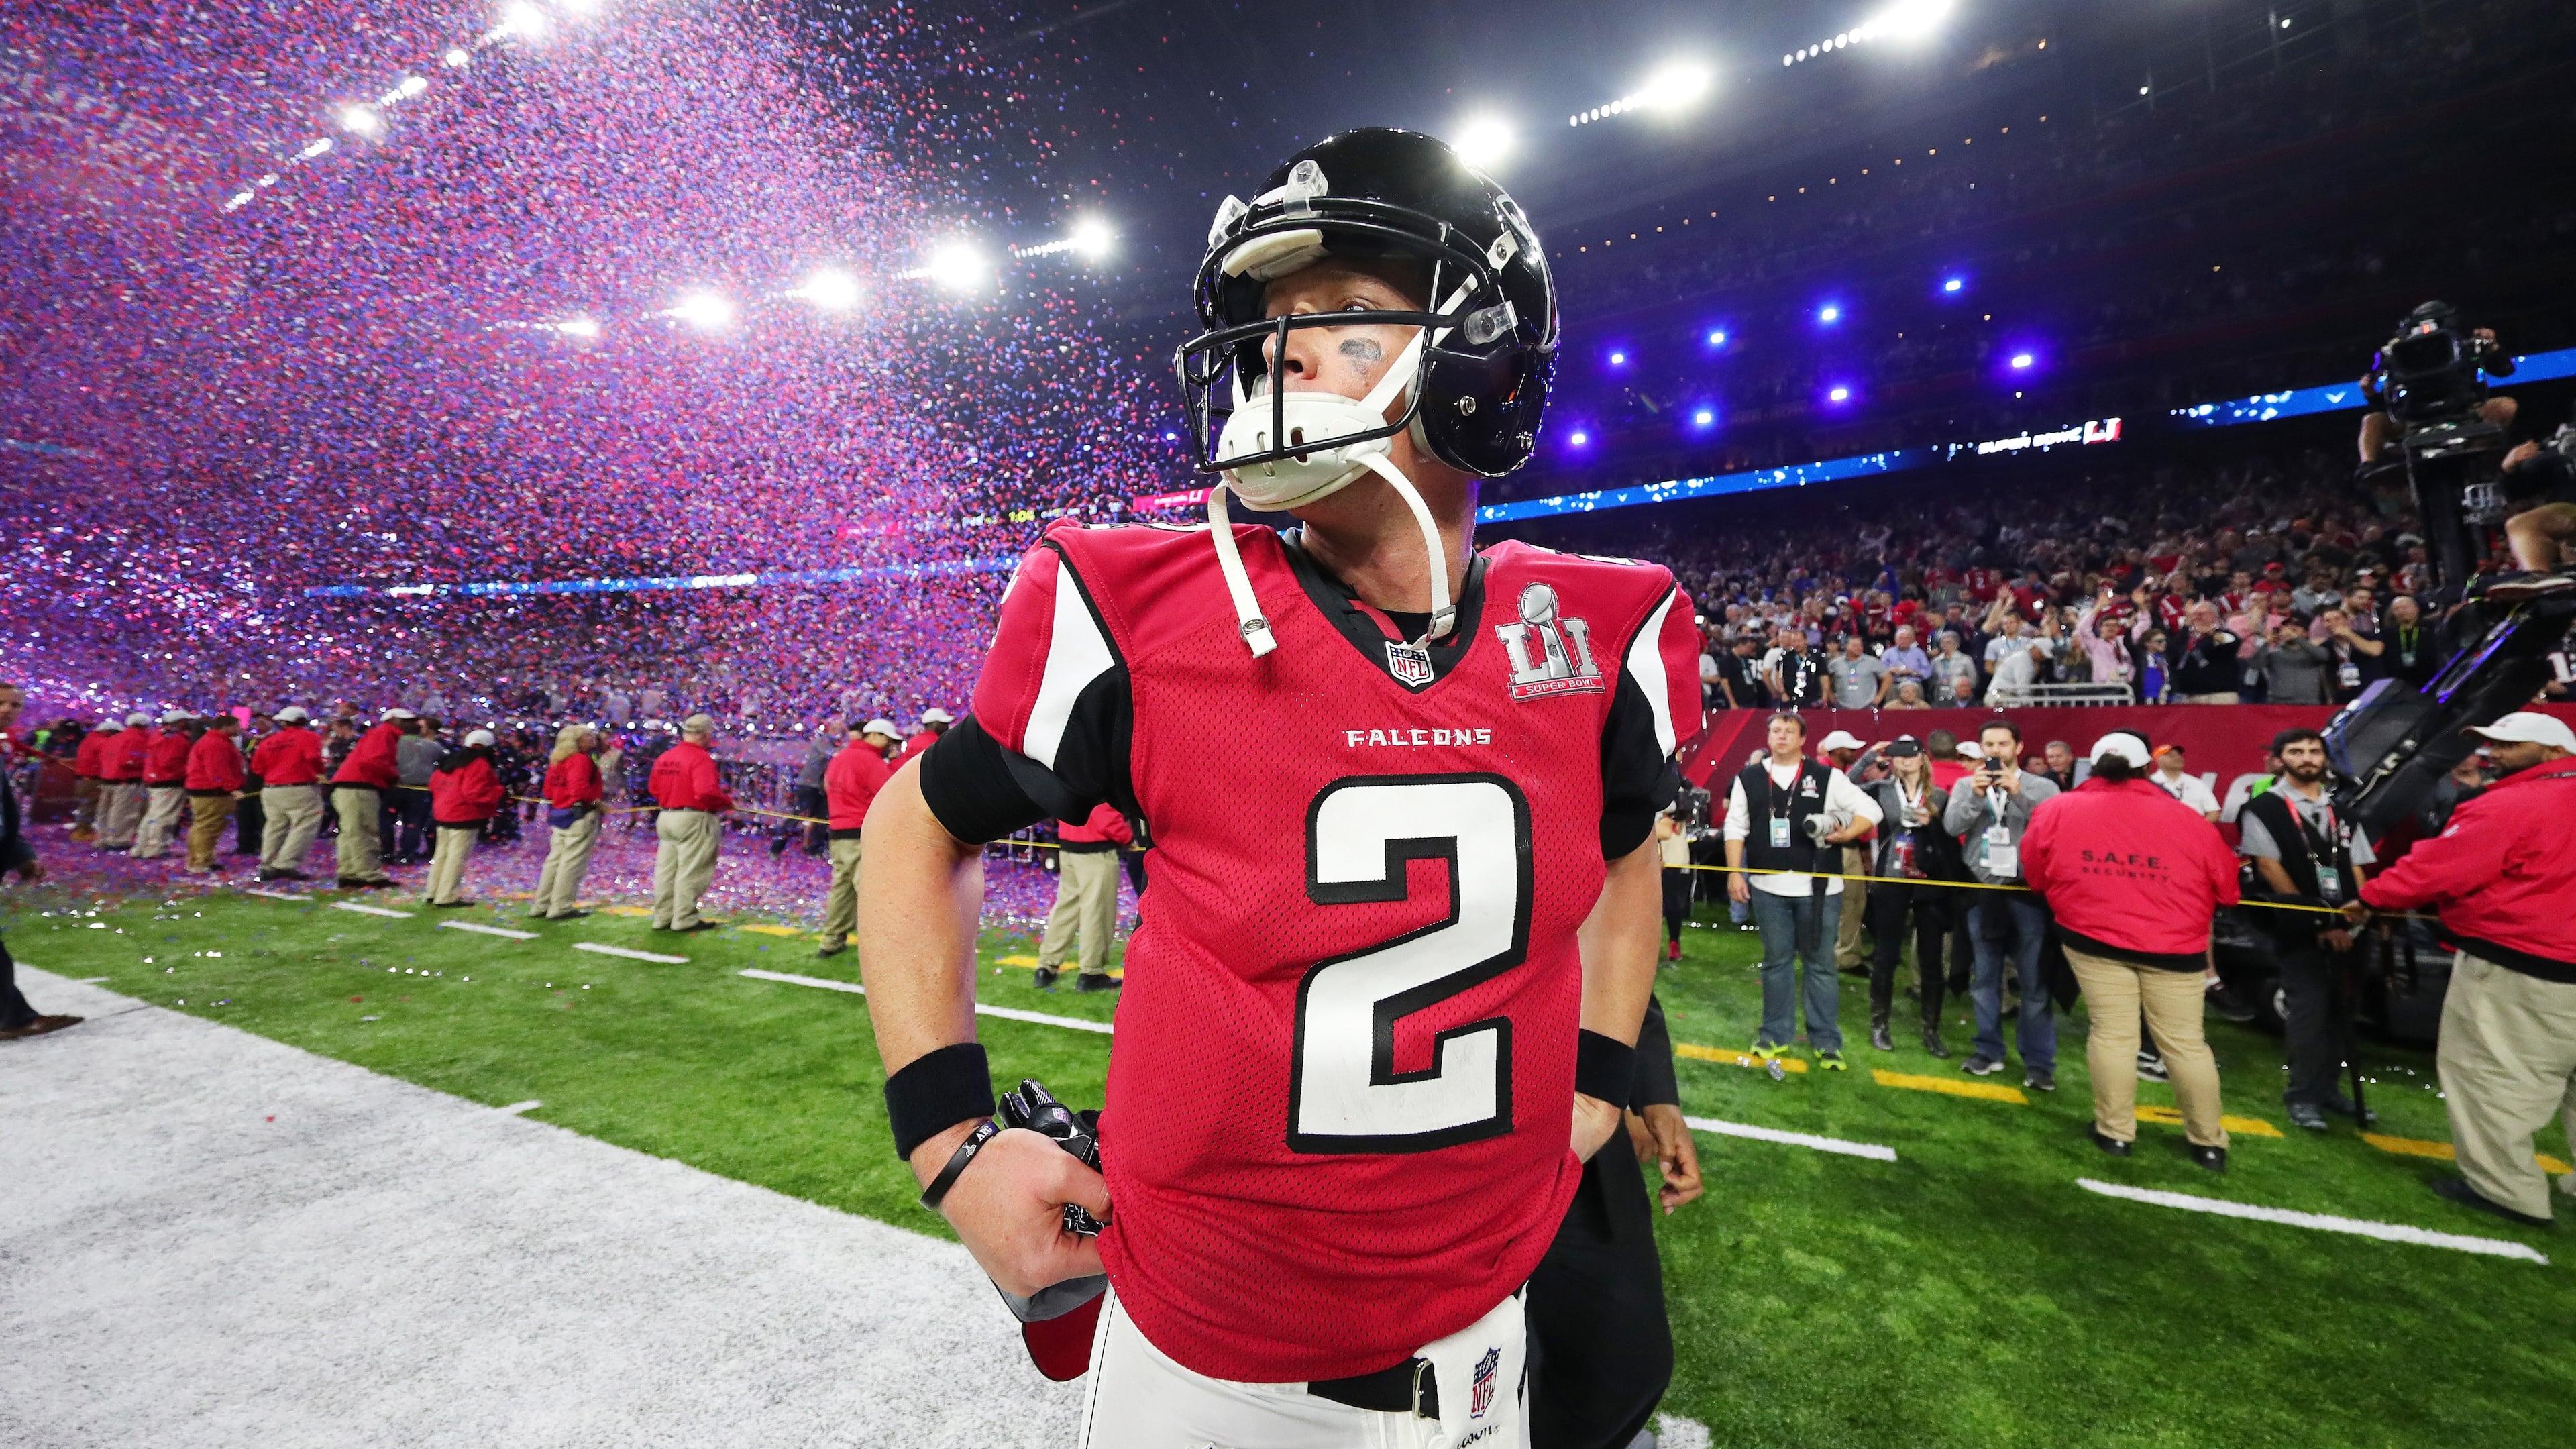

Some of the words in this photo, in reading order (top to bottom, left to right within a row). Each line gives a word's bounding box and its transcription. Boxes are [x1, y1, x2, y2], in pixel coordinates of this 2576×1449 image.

[1395, 657, 1428, 678] NFL
[1525, 680, 1566, 694] SUPER
[1568, 678, 1595, 688] BOWL
[1345, 728, 1491, 747] FALCONS
[1287, 772, 1534, 1155] 2
[1471, 1371, 1494, 1413] NFL
